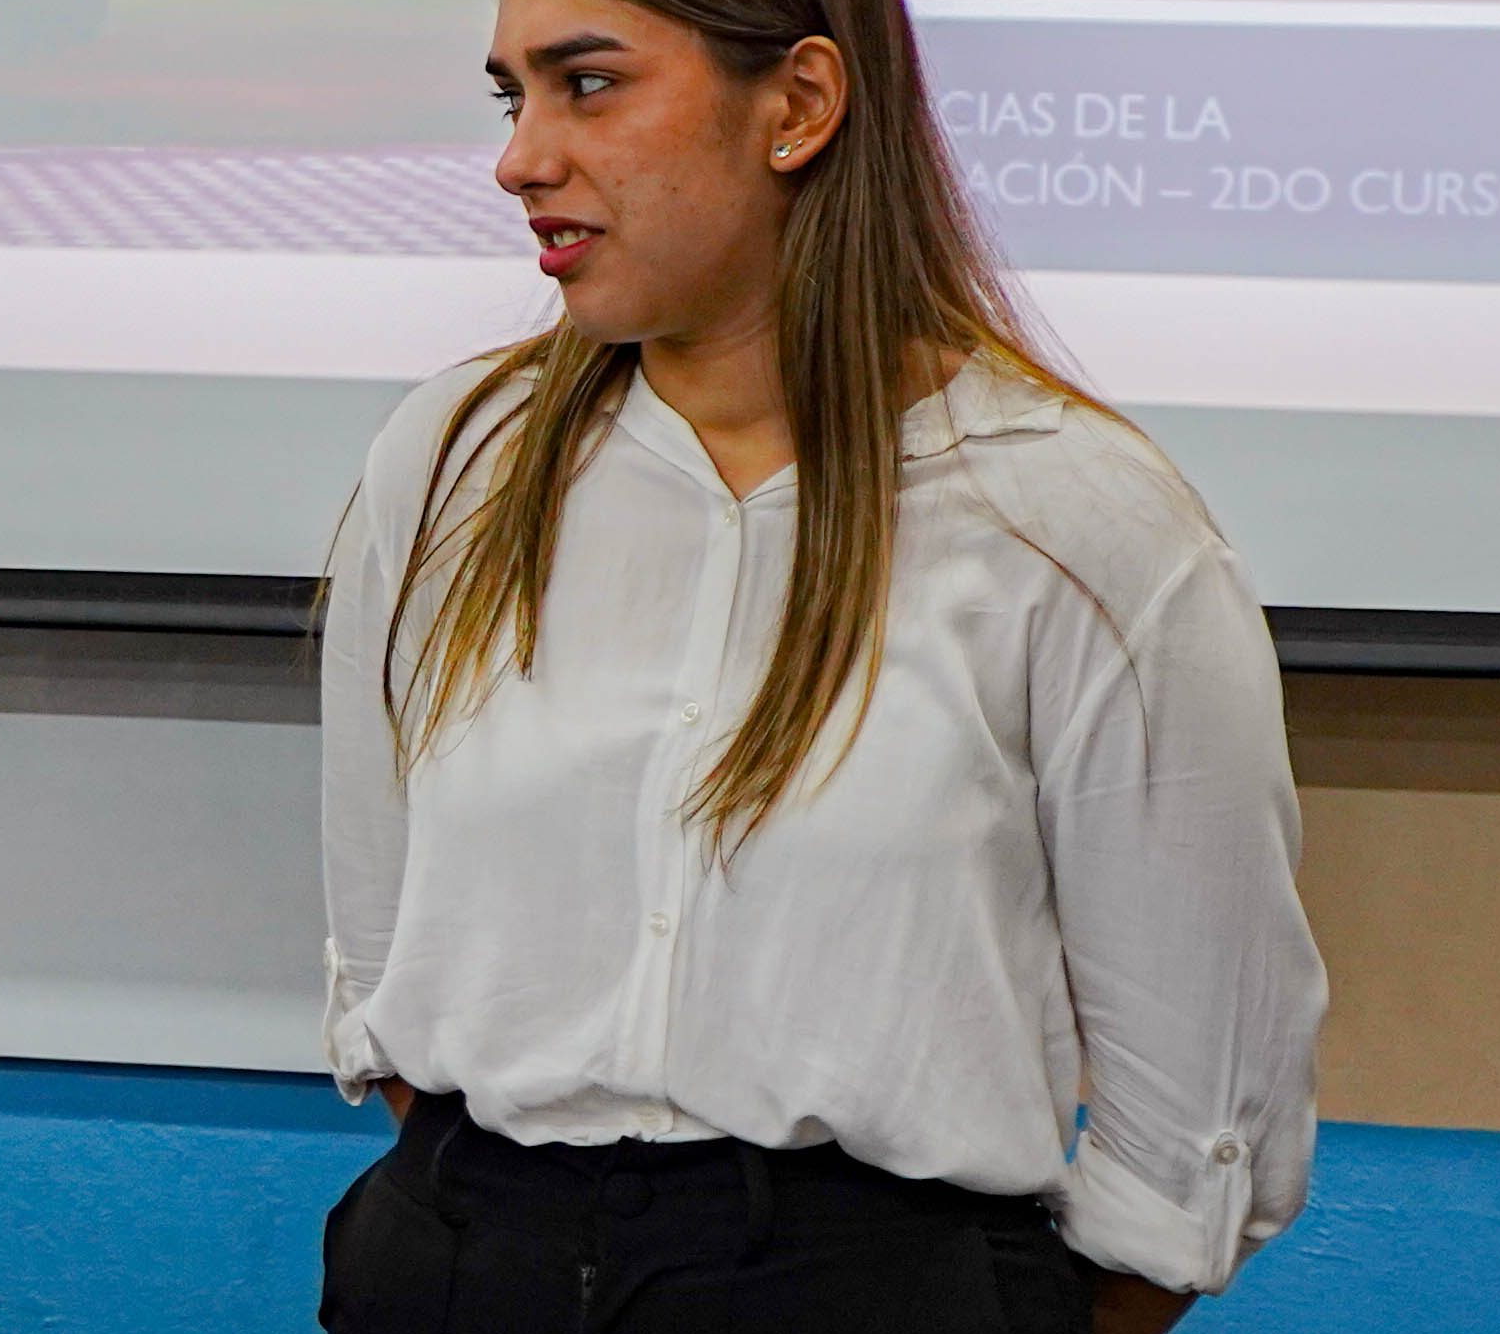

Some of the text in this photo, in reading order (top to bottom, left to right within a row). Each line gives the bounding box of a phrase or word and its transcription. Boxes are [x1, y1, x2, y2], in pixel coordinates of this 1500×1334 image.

[940, 89, 1231, 142] CIAS DE LA
[966, 151, 1144, 208] ACIÓN
[1209, 167, 1331, 213] 2DO
